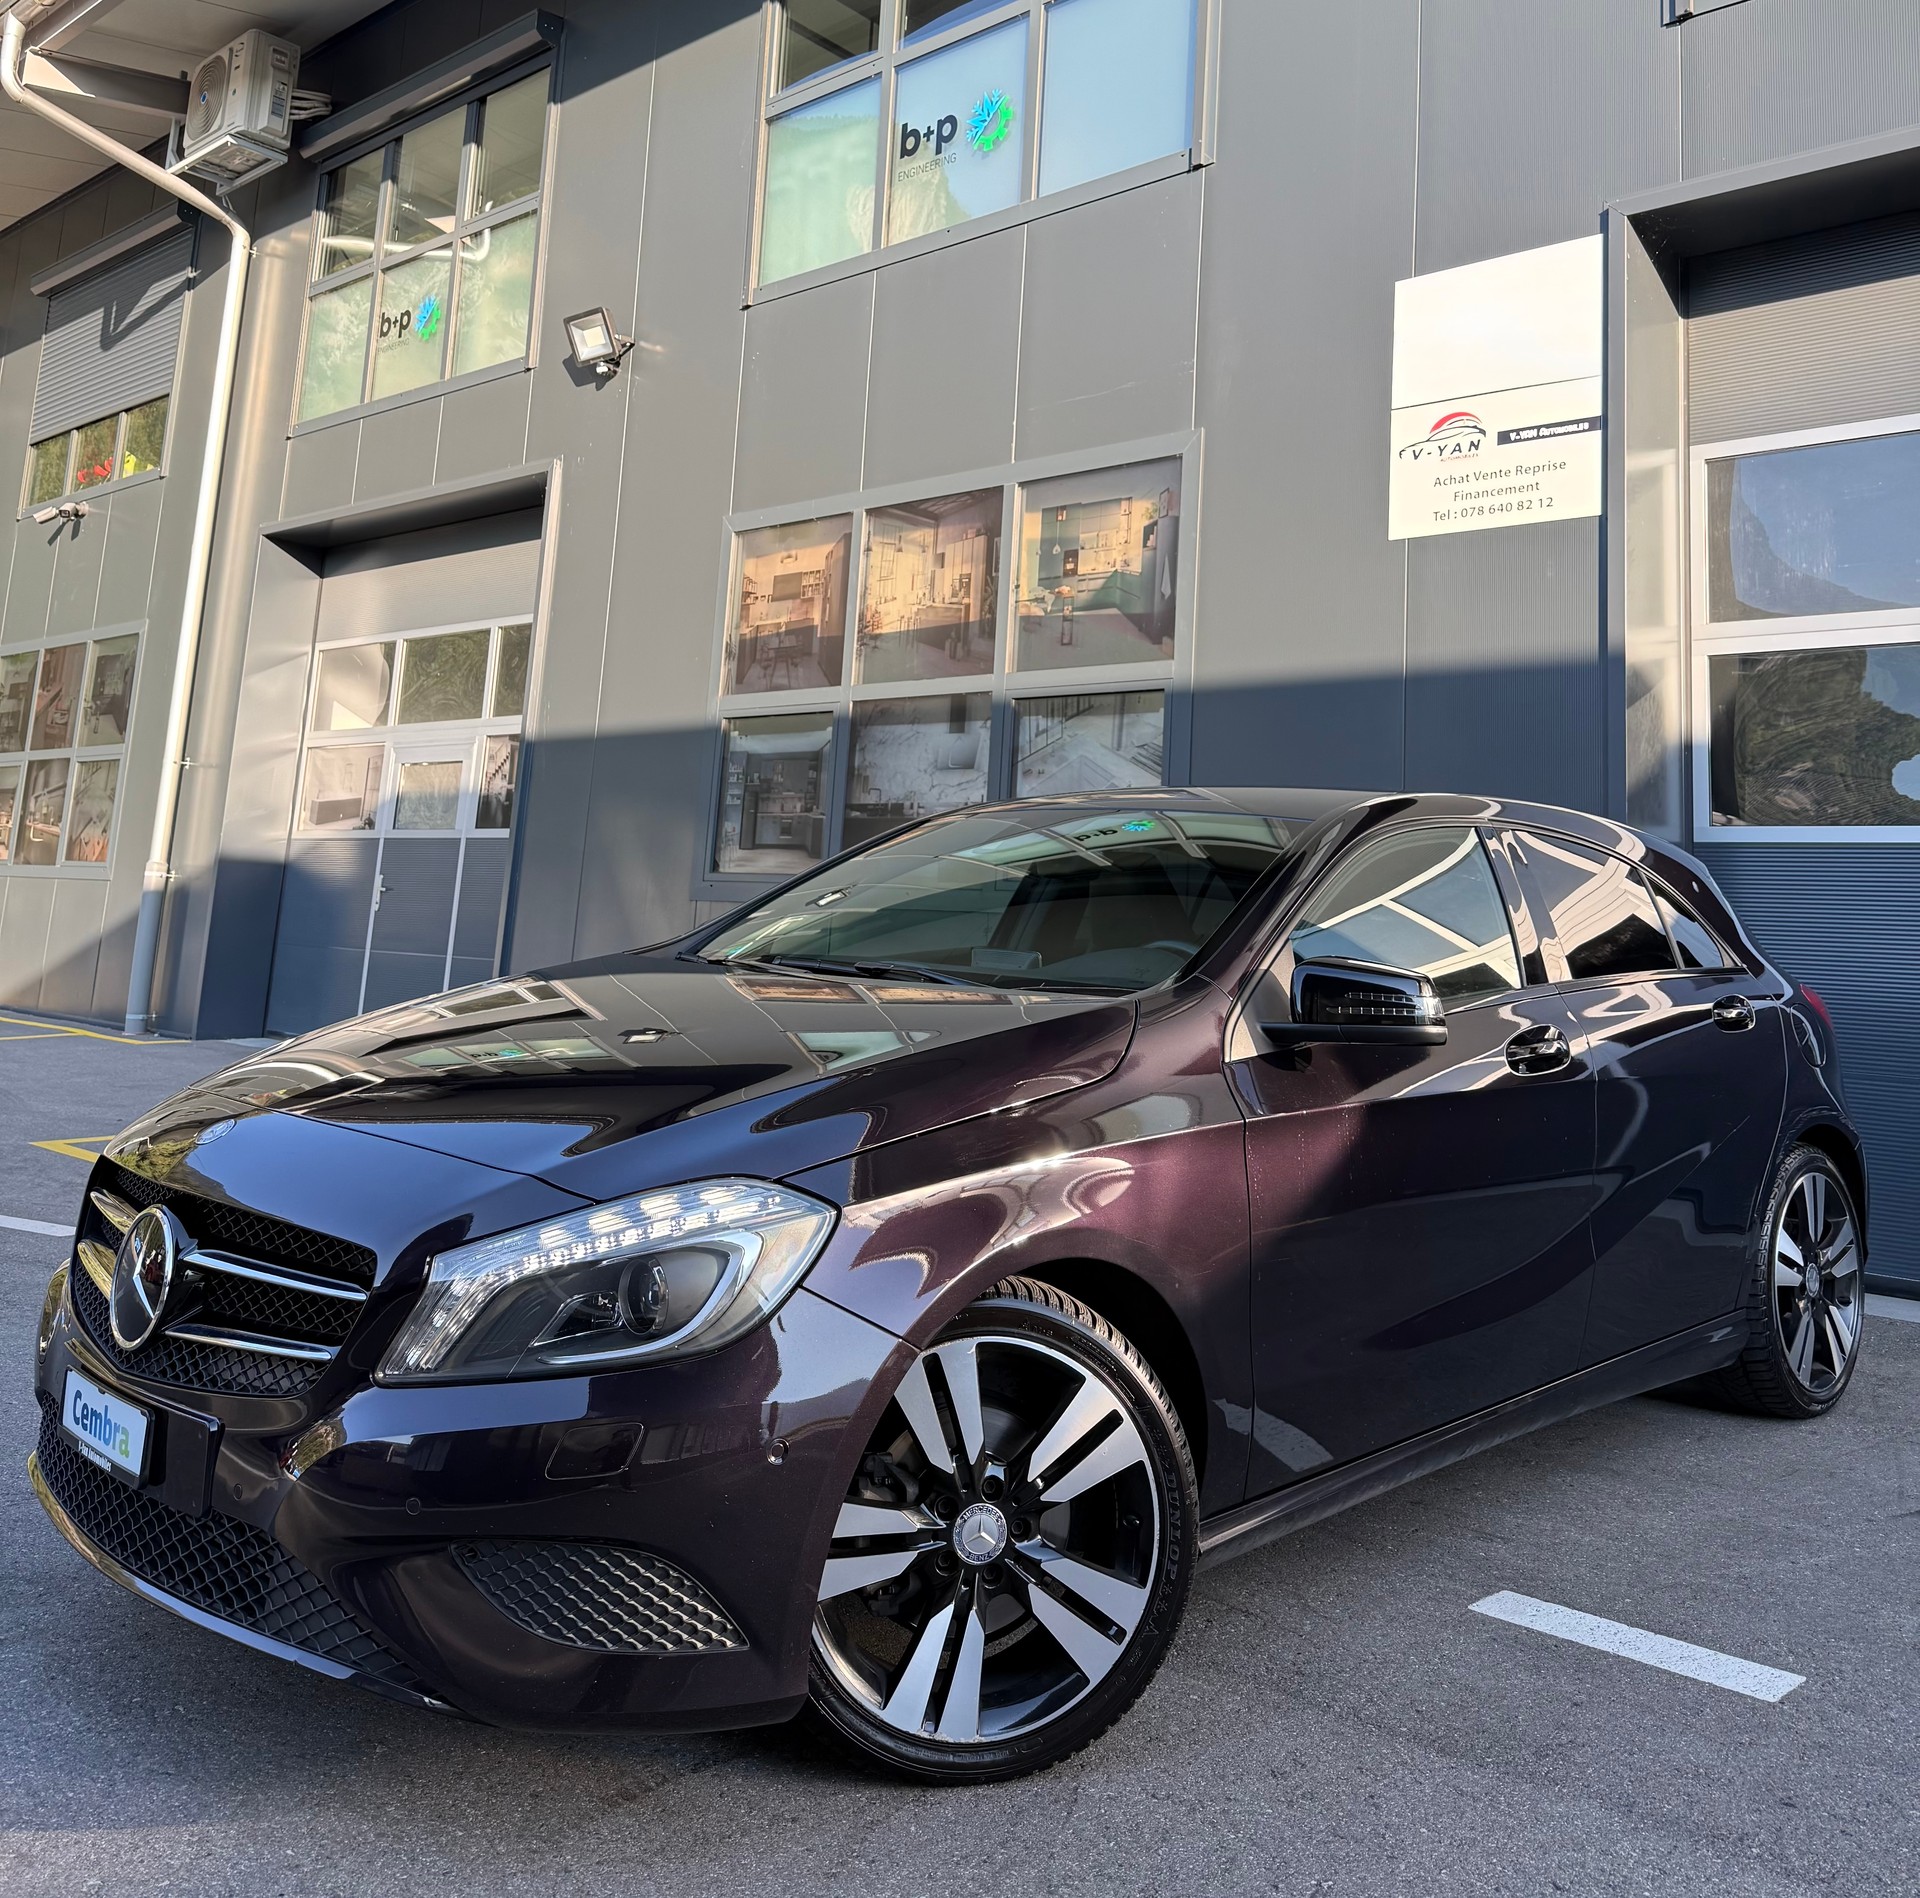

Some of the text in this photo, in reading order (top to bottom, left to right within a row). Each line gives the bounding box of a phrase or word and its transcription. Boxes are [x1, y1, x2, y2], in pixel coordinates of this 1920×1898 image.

[899, 114, 958, 159] b+p
[898, 152, 957, 182] ENGINEERING
[379, 309, 411, 338] b+p
[1412, 439, 1481, 461] V-YAN
[1433, 460, 1567, 487] Achat Vente Reprise
[1453, 482, 1540, 502] Financement
[1461, 504, 1485, 518] 078
[1488, 500, 1513, 515] 640
[1517, 499, 1533, 510] 82
[1539, 496, 1554, 508] 12
[72, 1389, 131, 1459] Cembra
[1165, 1472, 1183, 1580] DUNLOP
[969, 1553, 990, 1562] BENZ
